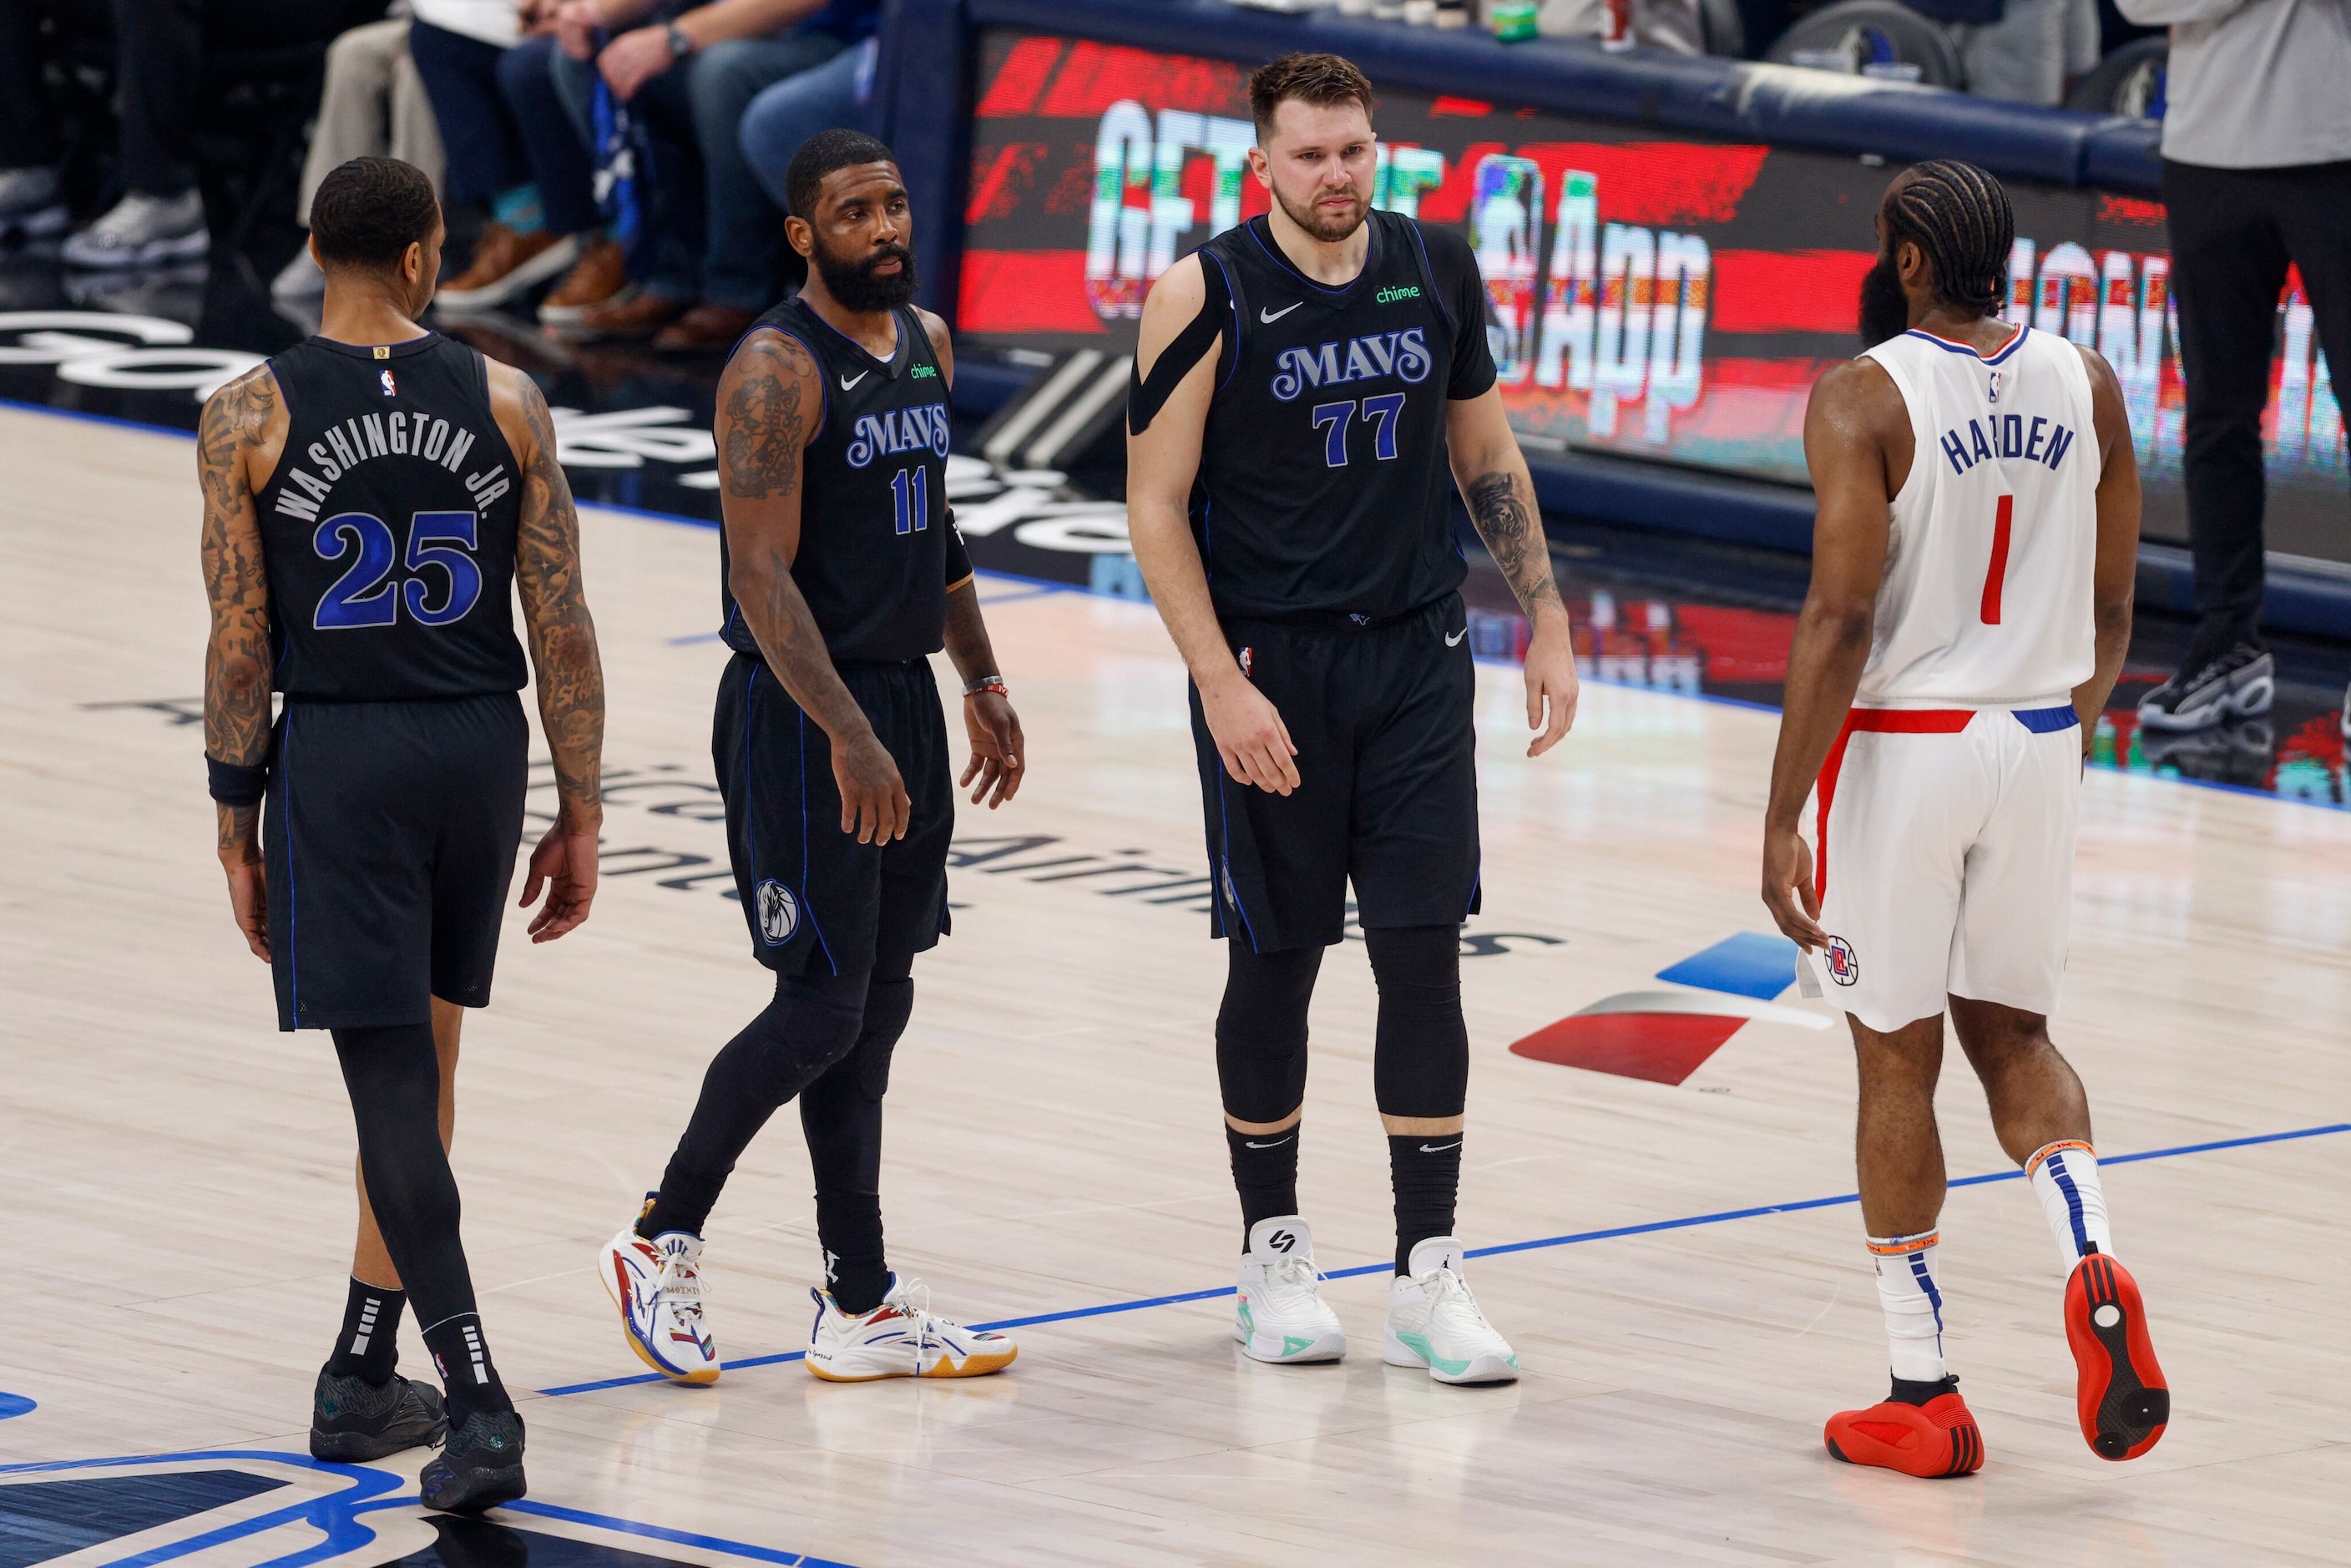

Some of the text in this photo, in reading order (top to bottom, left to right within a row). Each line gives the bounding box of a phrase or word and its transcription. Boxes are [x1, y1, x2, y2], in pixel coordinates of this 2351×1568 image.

[1376, 285, 1421, 305] chime
[1534, 169, 1712, 443] App
[910, 362, 937, 380] chime
[1271, 326, 1433, 402] MAVS
[275, 411, 511, 523] WASHINGTON JR.
[846, 402, 950, 469] MAVS
[1312, 392, 1406, 468] 77
[890, 465, 928, 536] 11
[313, 511, 483, 630] 25
[1980, 494, 2013, 625] 1
